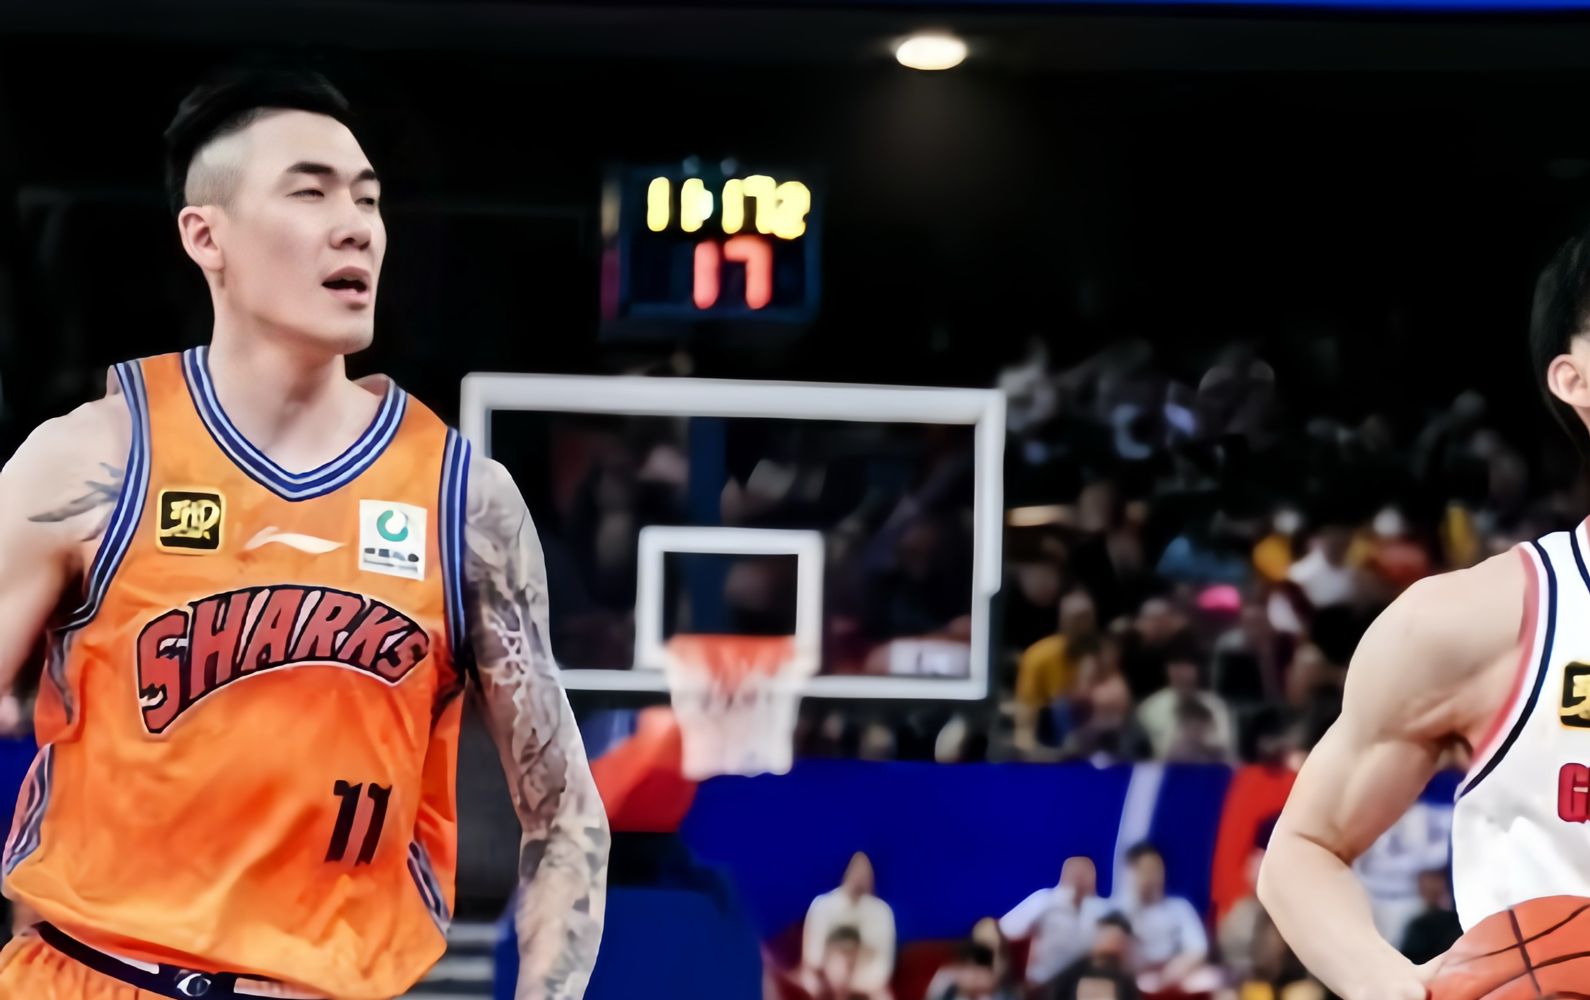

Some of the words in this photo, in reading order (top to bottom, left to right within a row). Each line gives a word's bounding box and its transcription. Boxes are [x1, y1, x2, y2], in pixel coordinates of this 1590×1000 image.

[693, 236, 772, 310] 17
[136, 584, 430, 735] SHARKS
[323, 779, 393, 867] 11
